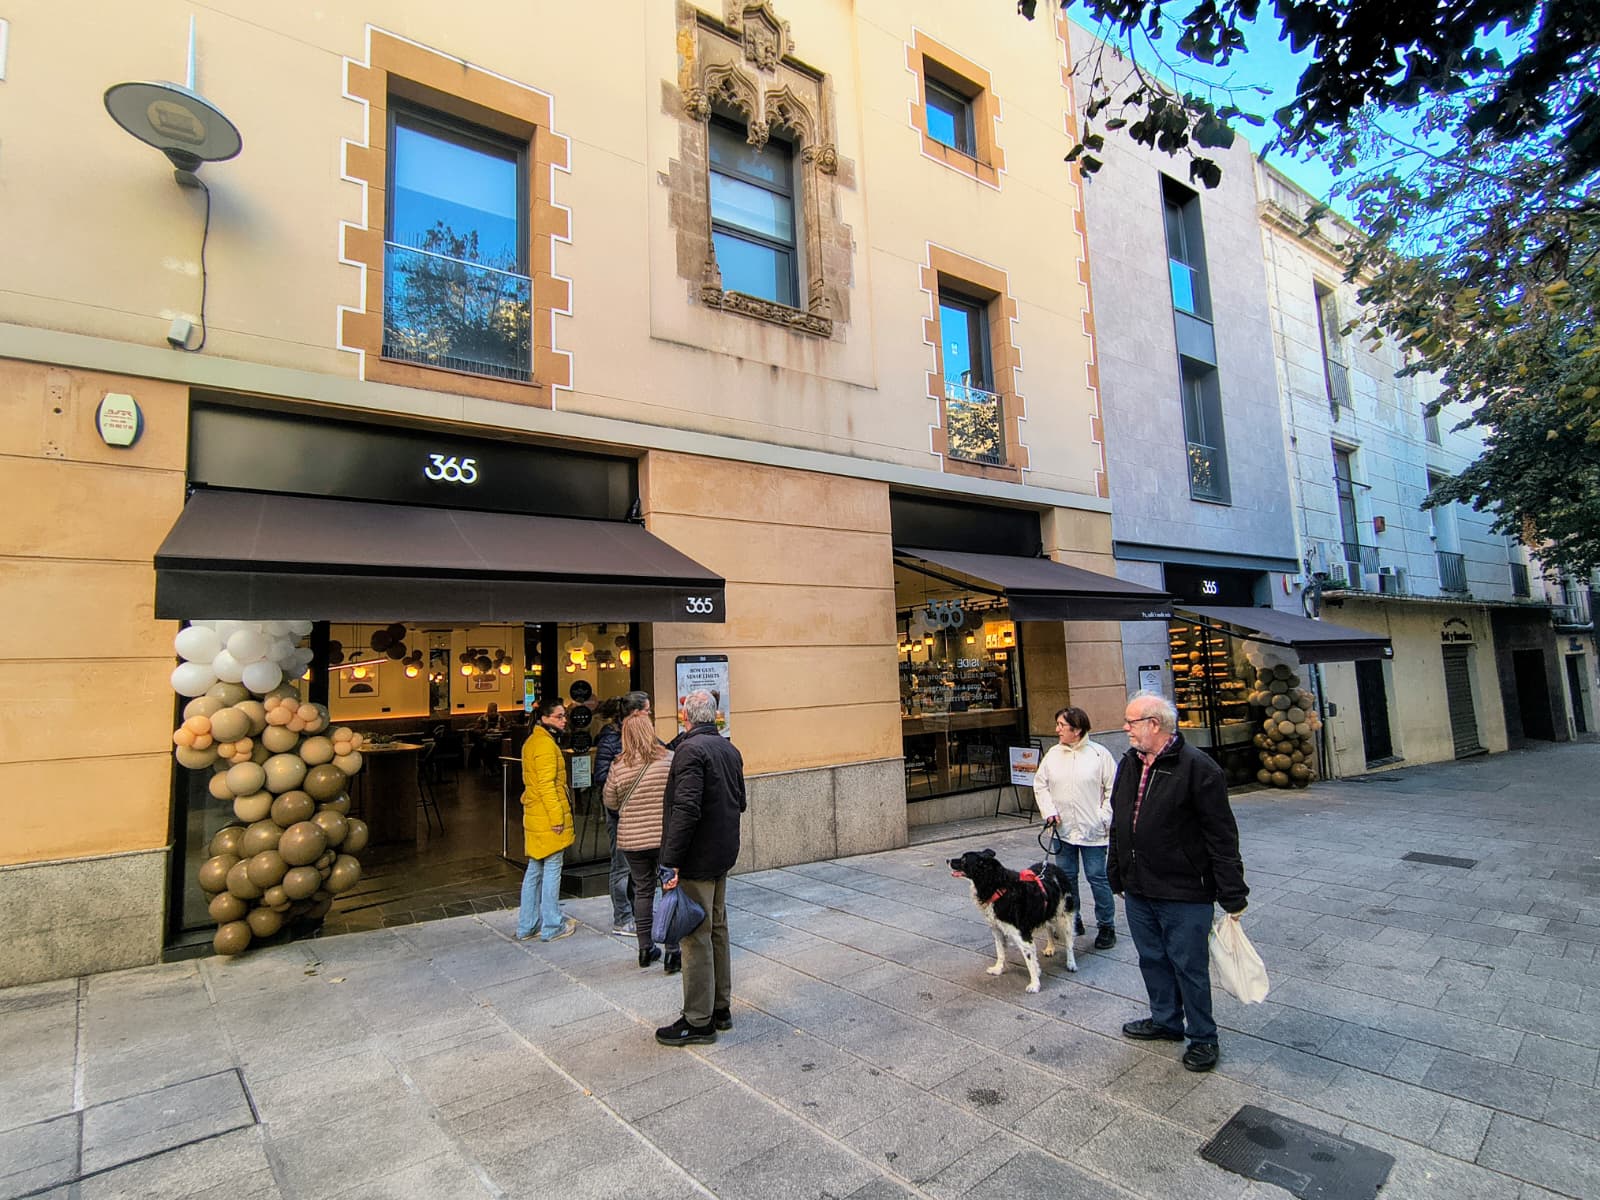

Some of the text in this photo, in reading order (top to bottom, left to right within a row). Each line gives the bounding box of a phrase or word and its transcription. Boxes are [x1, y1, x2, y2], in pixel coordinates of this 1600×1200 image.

[425, 454, 477, 484] 365
[1202, 580, 1217, 594] 365
[686, 597, 713, 613] 365
[923, 599, 964, 628] 365
